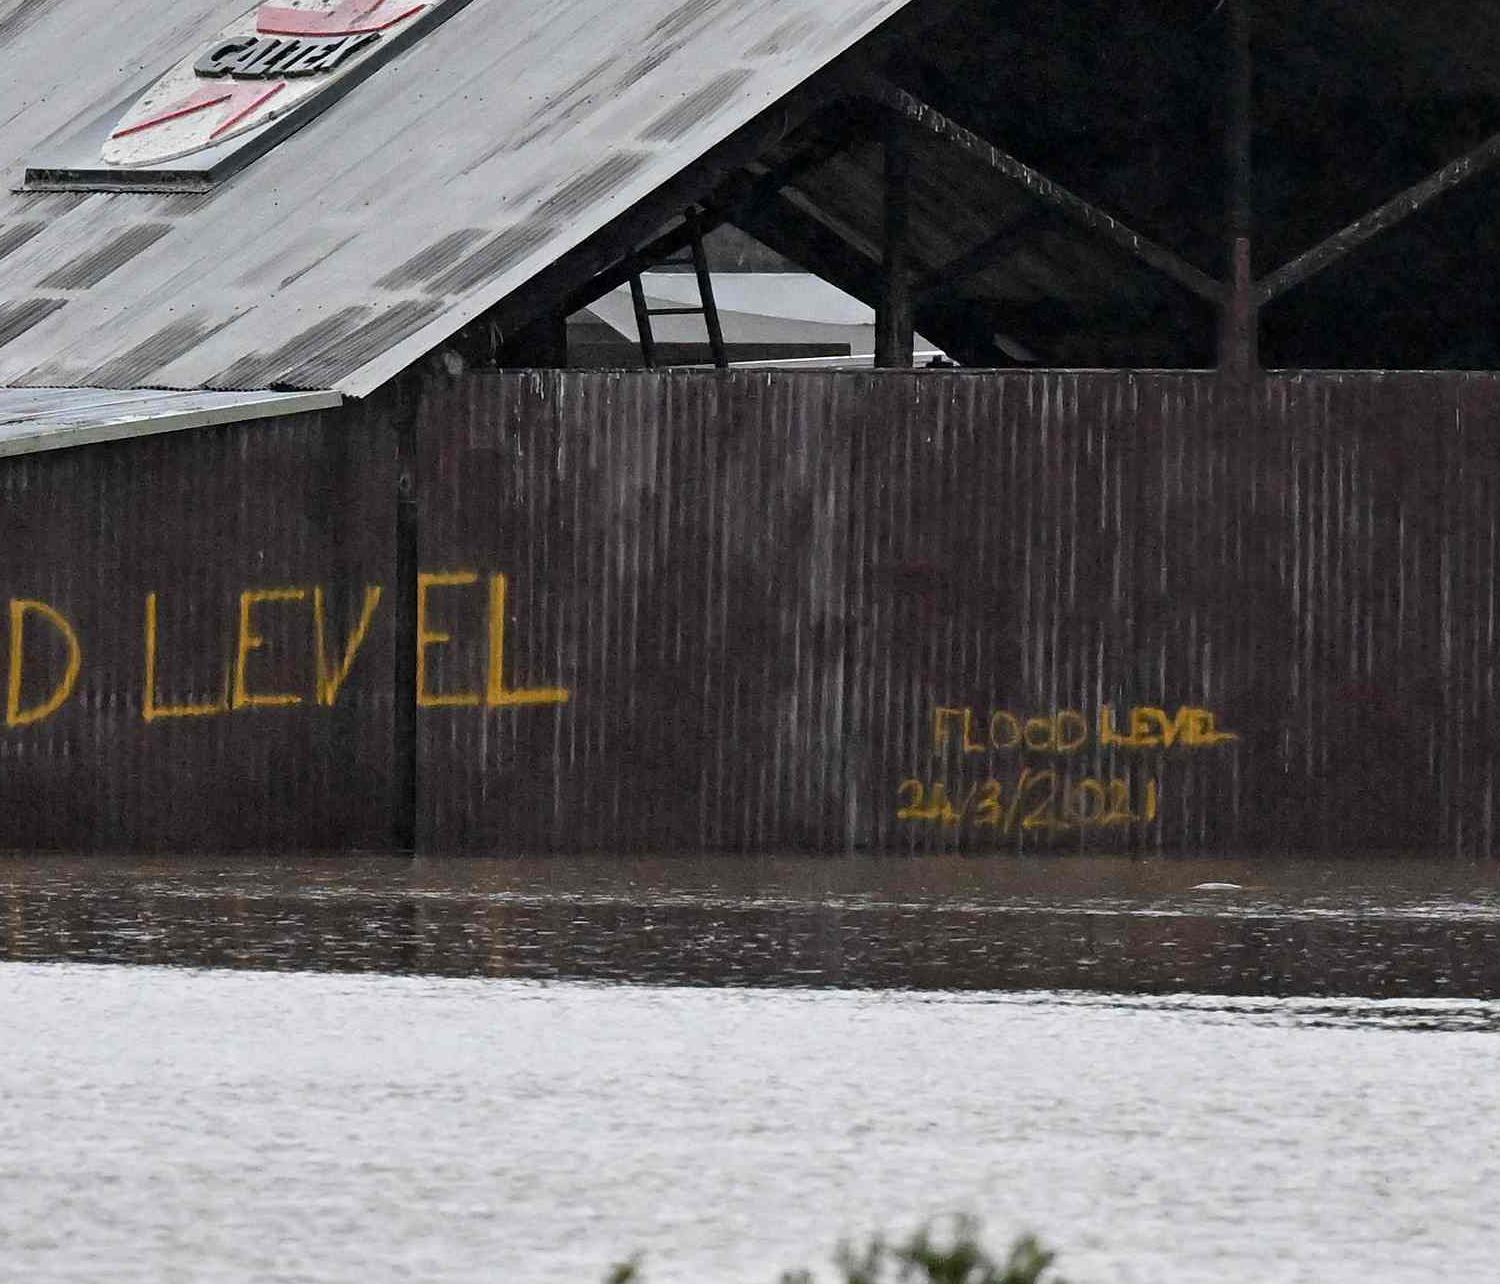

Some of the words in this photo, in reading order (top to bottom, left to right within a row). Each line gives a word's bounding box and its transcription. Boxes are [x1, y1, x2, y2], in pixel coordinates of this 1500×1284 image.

[193, 33, 383, 79] CALTEX
[142, 569, 570, 723] LEVEL
[934, 706, 1087, 753] FLOOD
[1101, 703, 1240, 749] LEVEL
